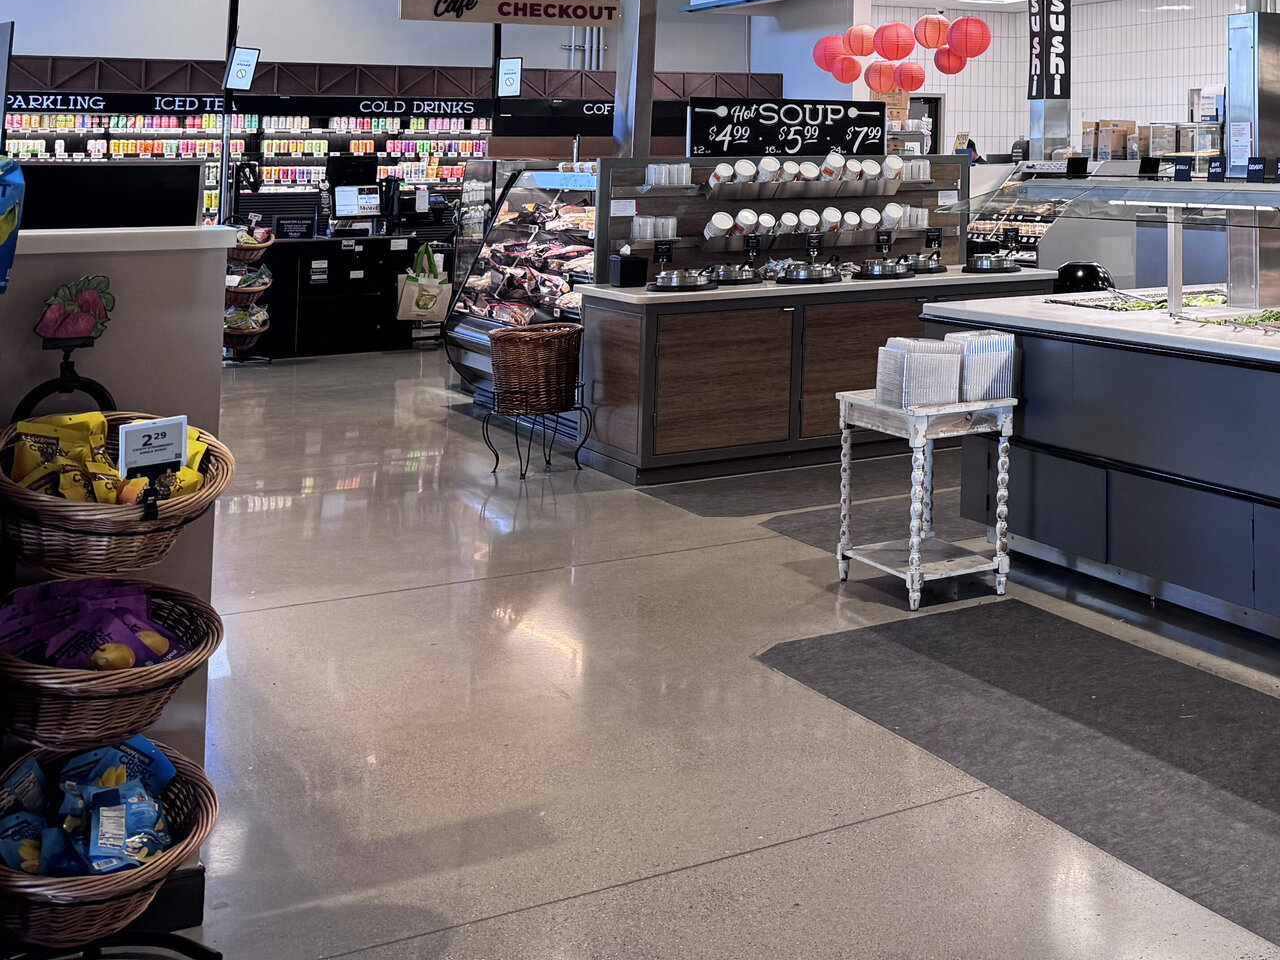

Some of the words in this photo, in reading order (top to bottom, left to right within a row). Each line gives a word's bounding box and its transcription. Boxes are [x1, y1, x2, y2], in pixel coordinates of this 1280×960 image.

[498, 1, 617, 21] CHECKOUT
[154, 97, 199, 111] ICED
[360, 100, 406, 113] COLD
[412, 101, 474, 114] DRINKS
[583, 103, 616, 115] COF
[731, 104, 758, 123] Hot
[758, 103, 845, 125] SOUP
[693, 146, 704, 154] 12
[765, 146, 776, 154] 16
[830, 146, 842, 154] 24
[119, 754, 156, 781] CRISPY
